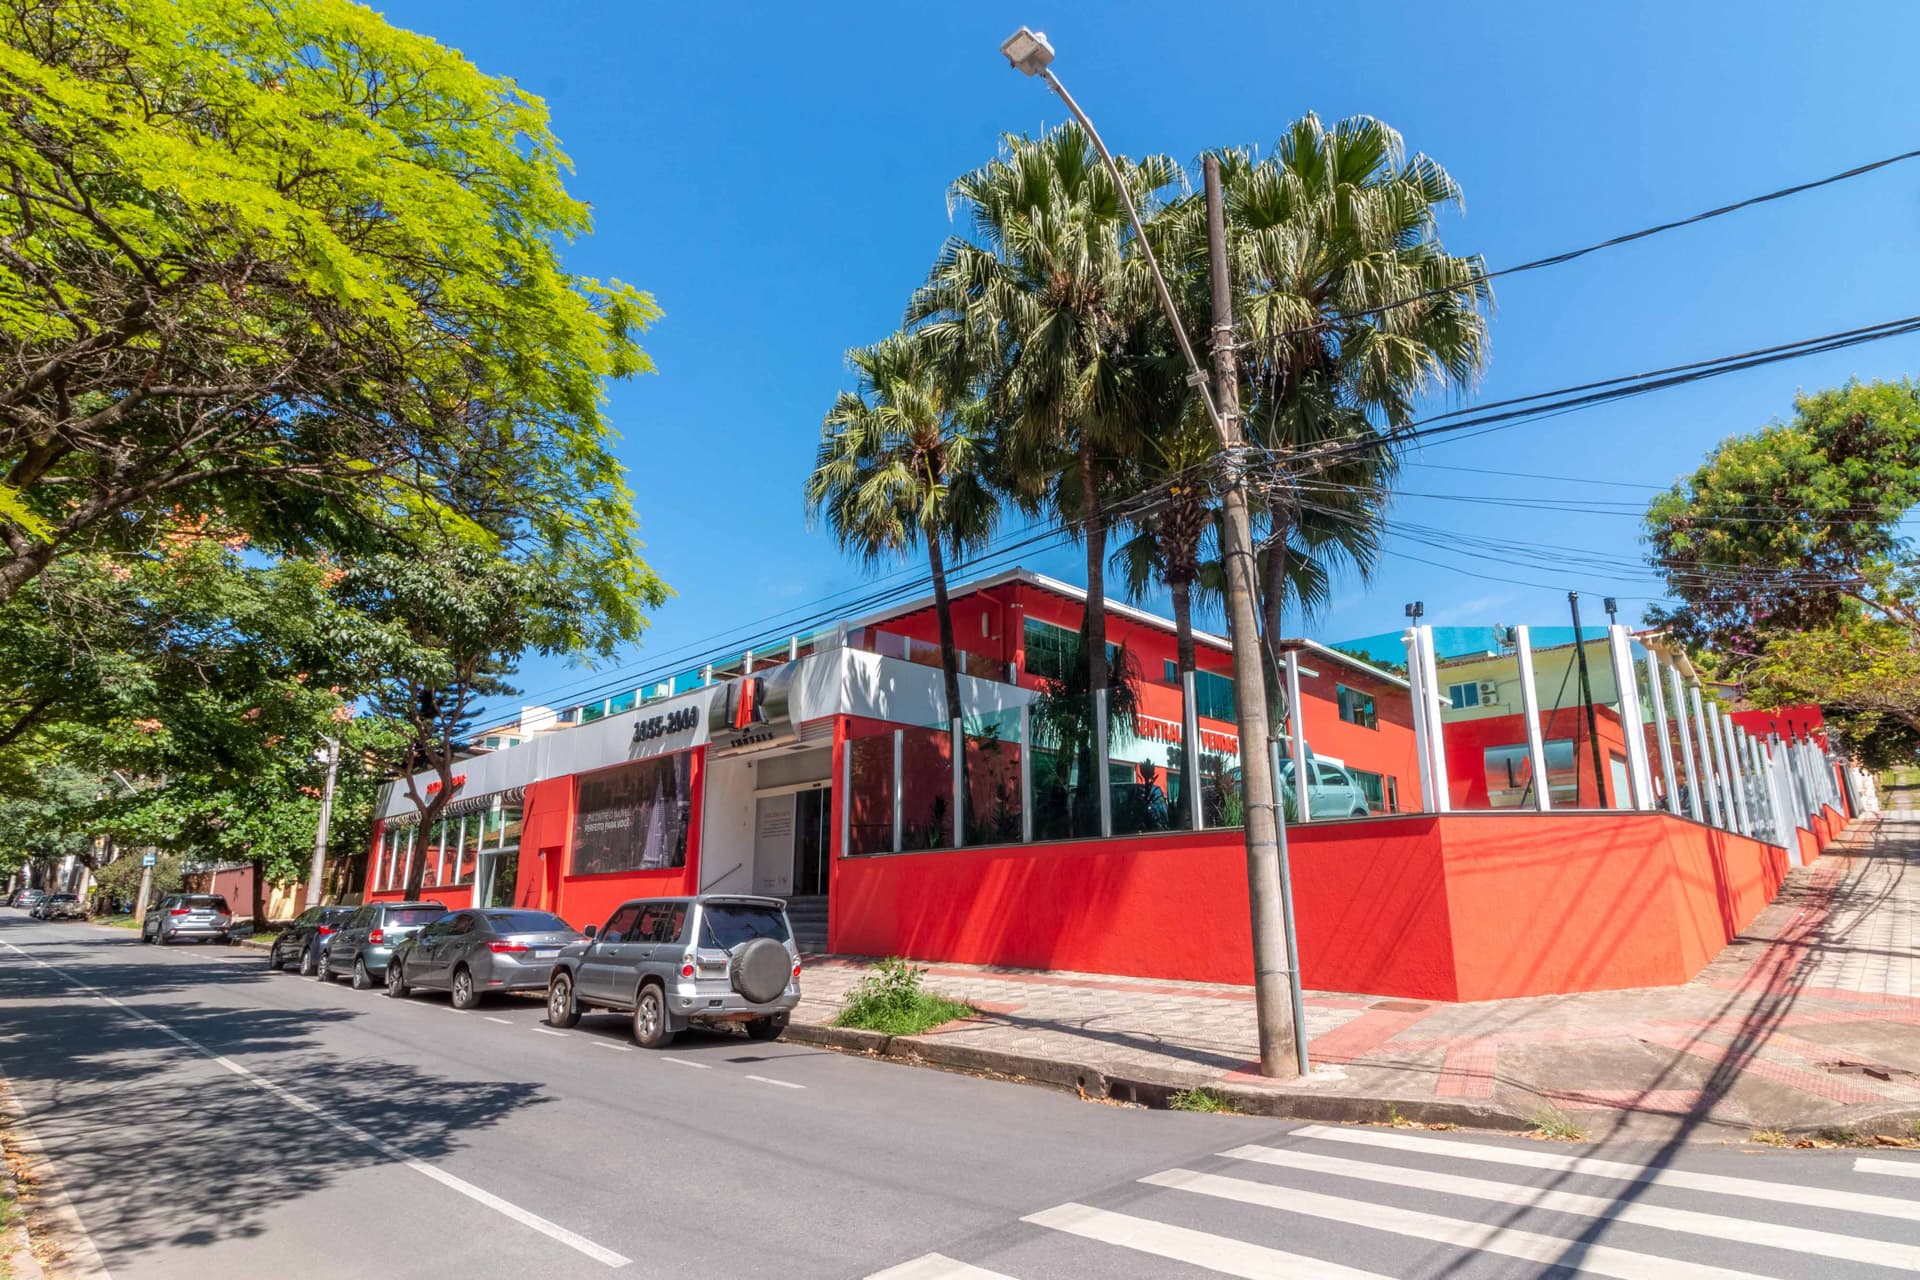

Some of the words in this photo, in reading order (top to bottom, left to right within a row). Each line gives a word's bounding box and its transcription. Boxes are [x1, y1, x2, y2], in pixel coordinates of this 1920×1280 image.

[1200, 731, 1238, 755] VENDAS
[584, 821, 604, 833] PERFEITO
[605, 819, 617, 831] PARA
